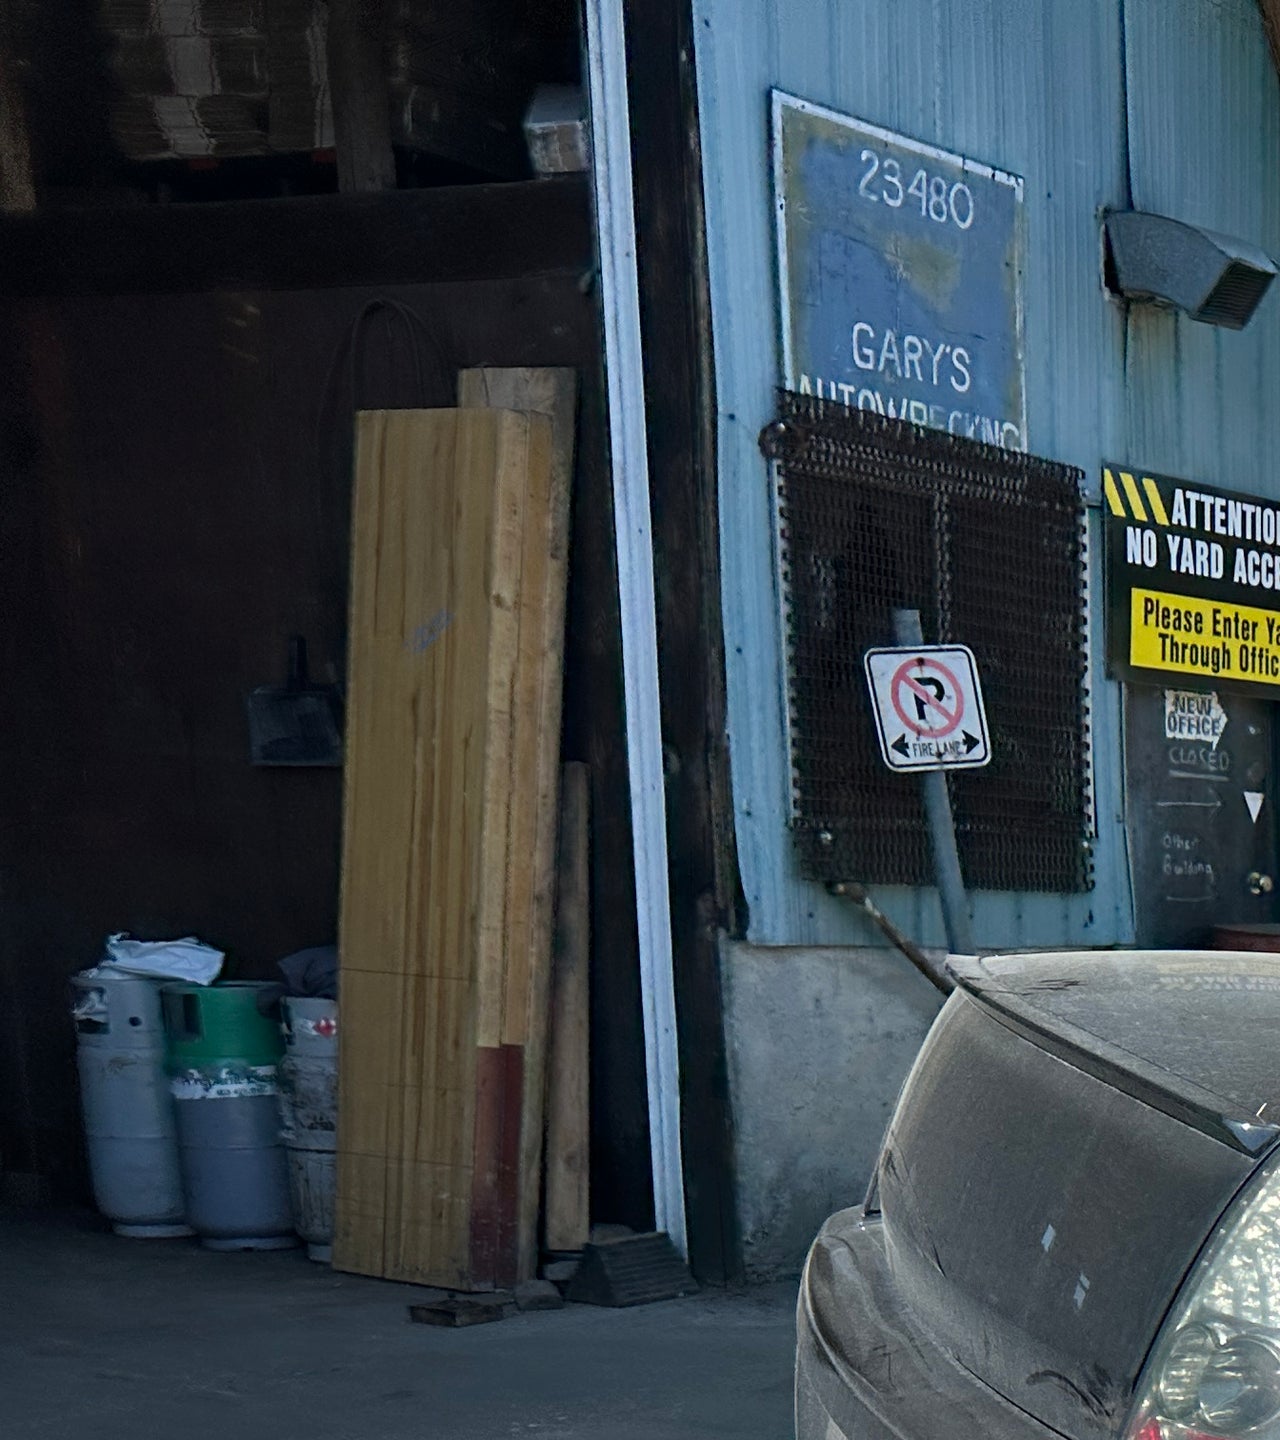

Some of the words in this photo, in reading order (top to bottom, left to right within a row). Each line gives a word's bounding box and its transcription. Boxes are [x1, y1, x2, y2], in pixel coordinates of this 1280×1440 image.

[859, 149, 974, 230] 23480
[852, 321, 971, 393] GARY'S
[1126, 526, 1157, 568] NO
[1166, 534, 1224, 579] YARD
[1143, 596, 1203, 634] Please
[1212, 608, 1258, 641] Enter
[1158, 632, 1231, 673] Through
[1168, 714, 1220, 736] OFFICE
[1174, 695, 1211, 715] NEW
[912, 742, 934, 757] FIRE
